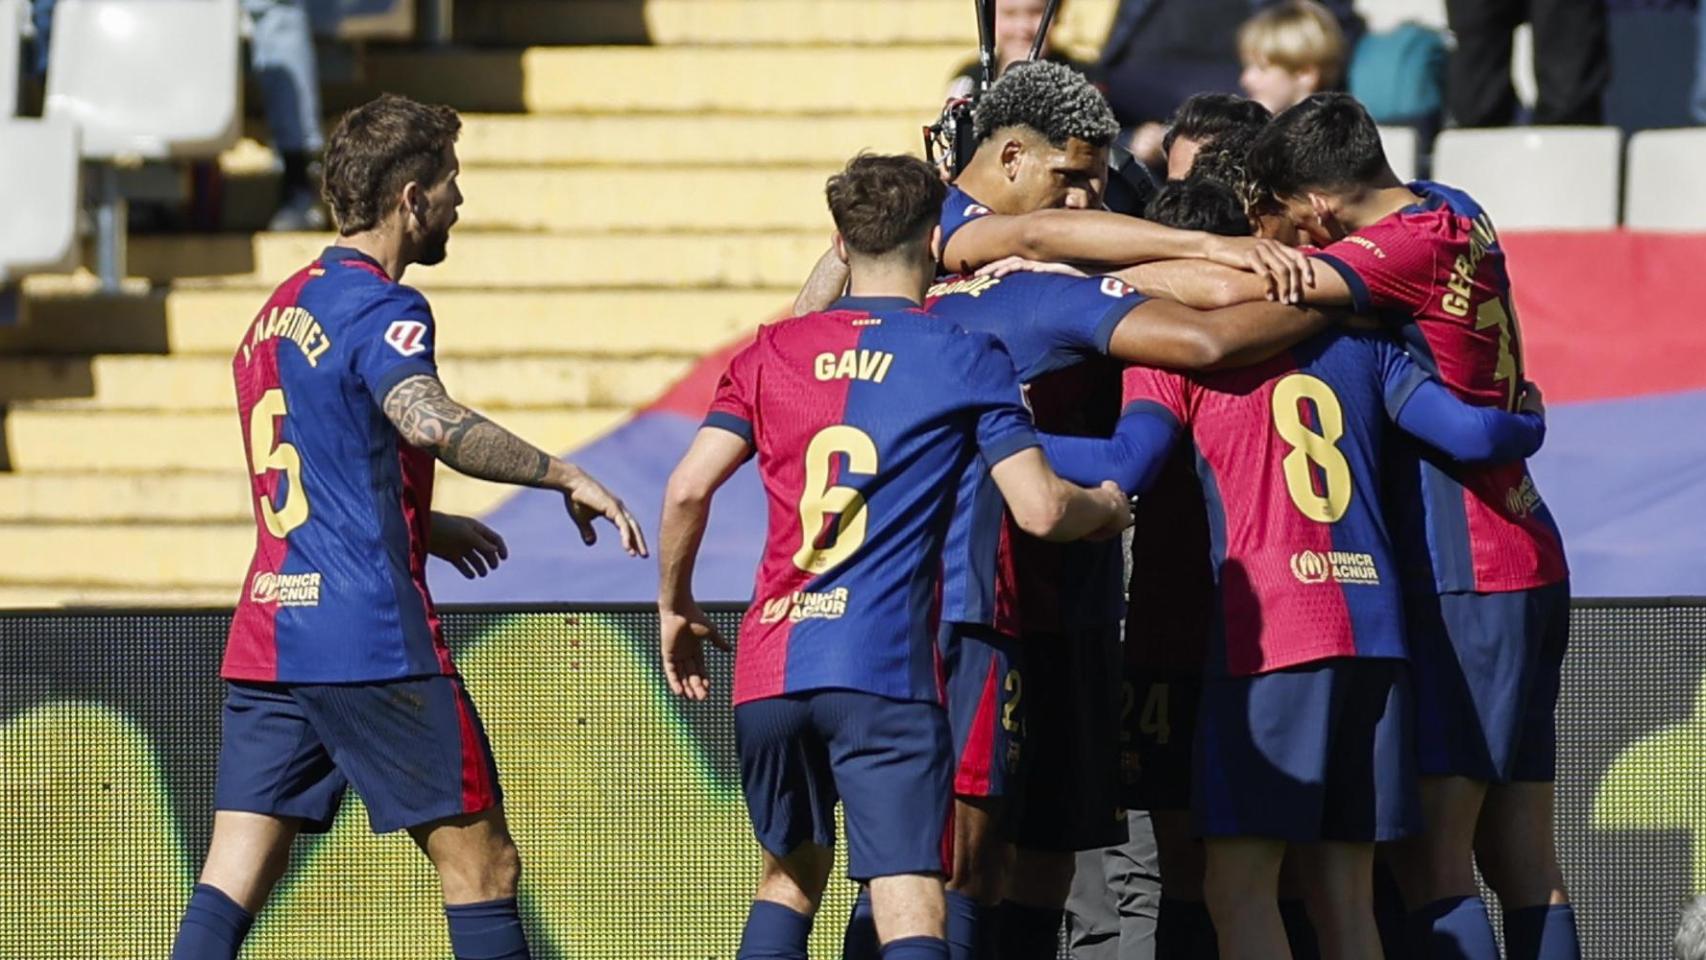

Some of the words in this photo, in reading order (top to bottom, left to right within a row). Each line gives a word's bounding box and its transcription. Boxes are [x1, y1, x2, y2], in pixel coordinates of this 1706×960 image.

[814, 350, 893, 384] GAVI
[250, 388, 309, 539] 5
[1271, 372, 1353, 524] 8
[792, 424, 879, 575] 6
[1327, 551, 1375, 567] UNHCR
[1332, 565, 1378, 579] ACNUR
[1119, 681, 1171, 744] 24
